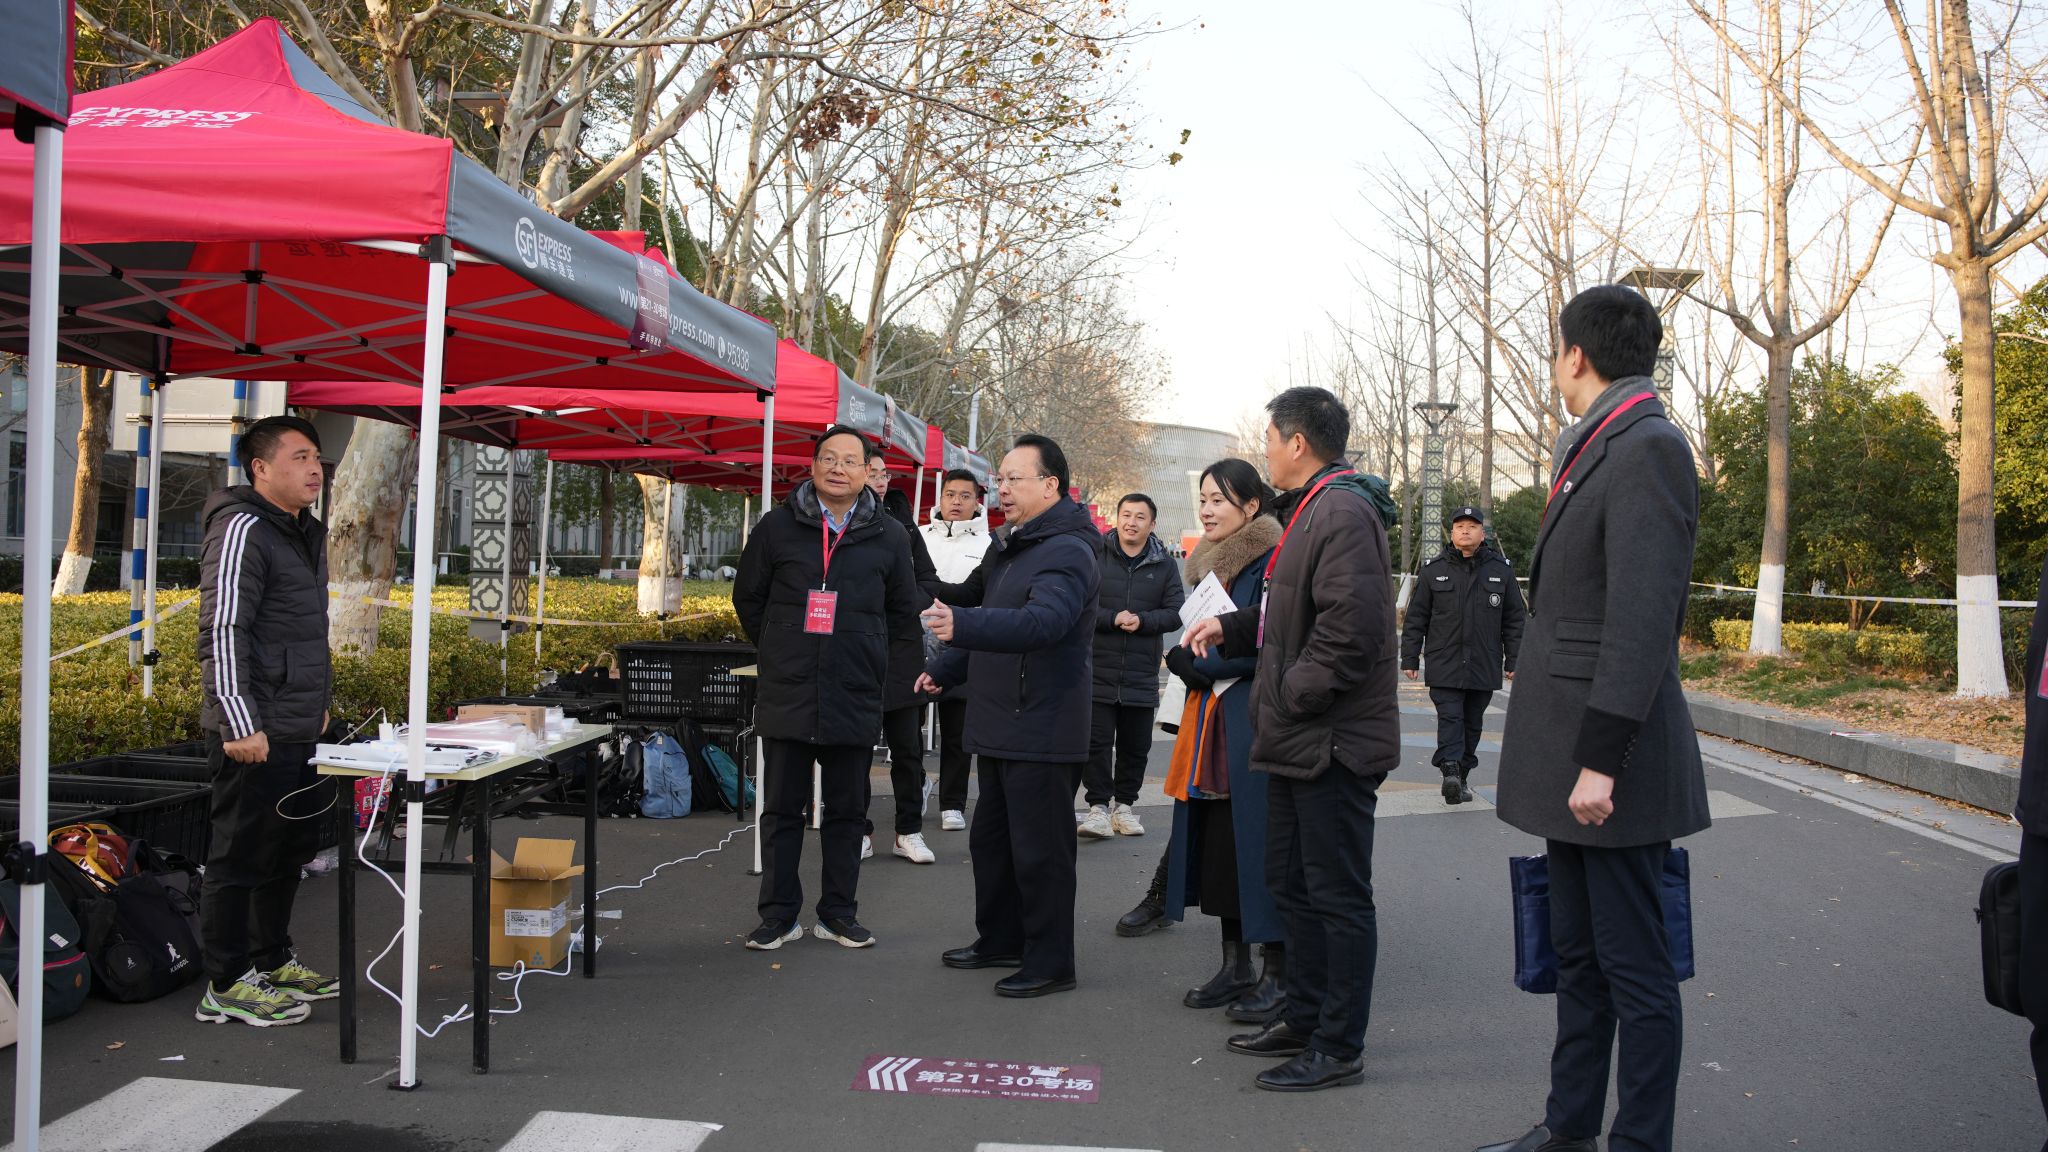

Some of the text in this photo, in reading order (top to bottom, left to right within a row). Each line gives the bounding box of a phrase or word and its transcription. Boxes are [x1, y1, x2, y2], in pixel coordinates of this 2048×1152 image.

[71, 107, 259, 122] EXPRESS
[538, 232, 572, 263] EXPRESS
[727, 341, 750, 372] 95338
[169, 958, 190, 974] KANGOL
[915, 1069, 1094, 1091] 第21-30考场
